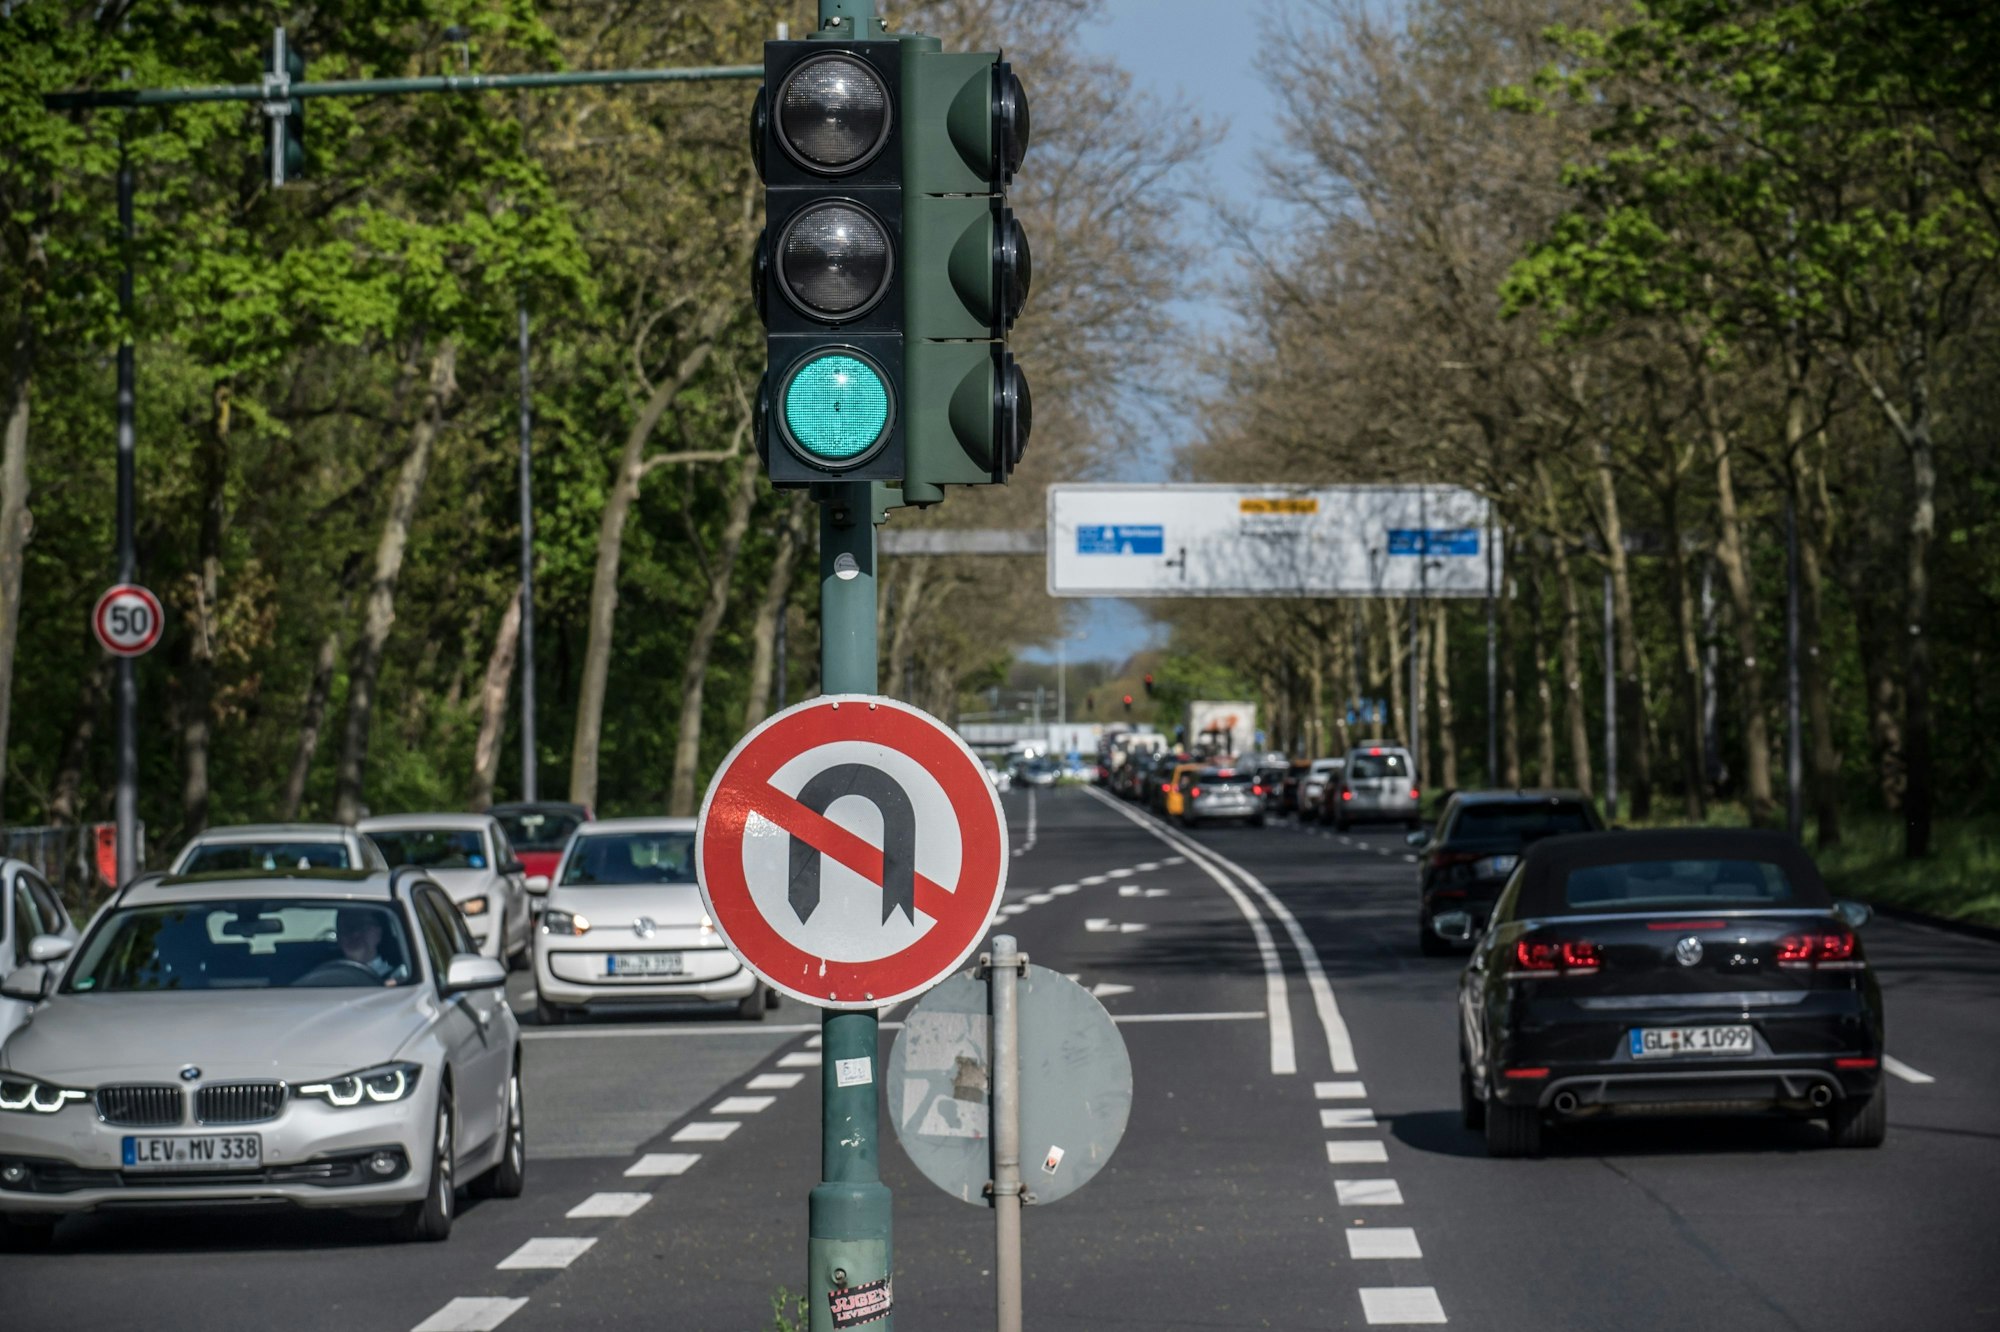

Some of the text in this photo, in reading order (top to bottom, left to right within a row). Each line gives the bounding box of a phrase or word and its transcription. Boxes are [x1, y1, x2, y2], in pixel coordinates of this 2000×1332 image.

[112, 605, 148, 636] 50
[1645, 1027, 1750, 1050] GL K 1099
[137, 1137, 258, 1161] LEV MV 338
